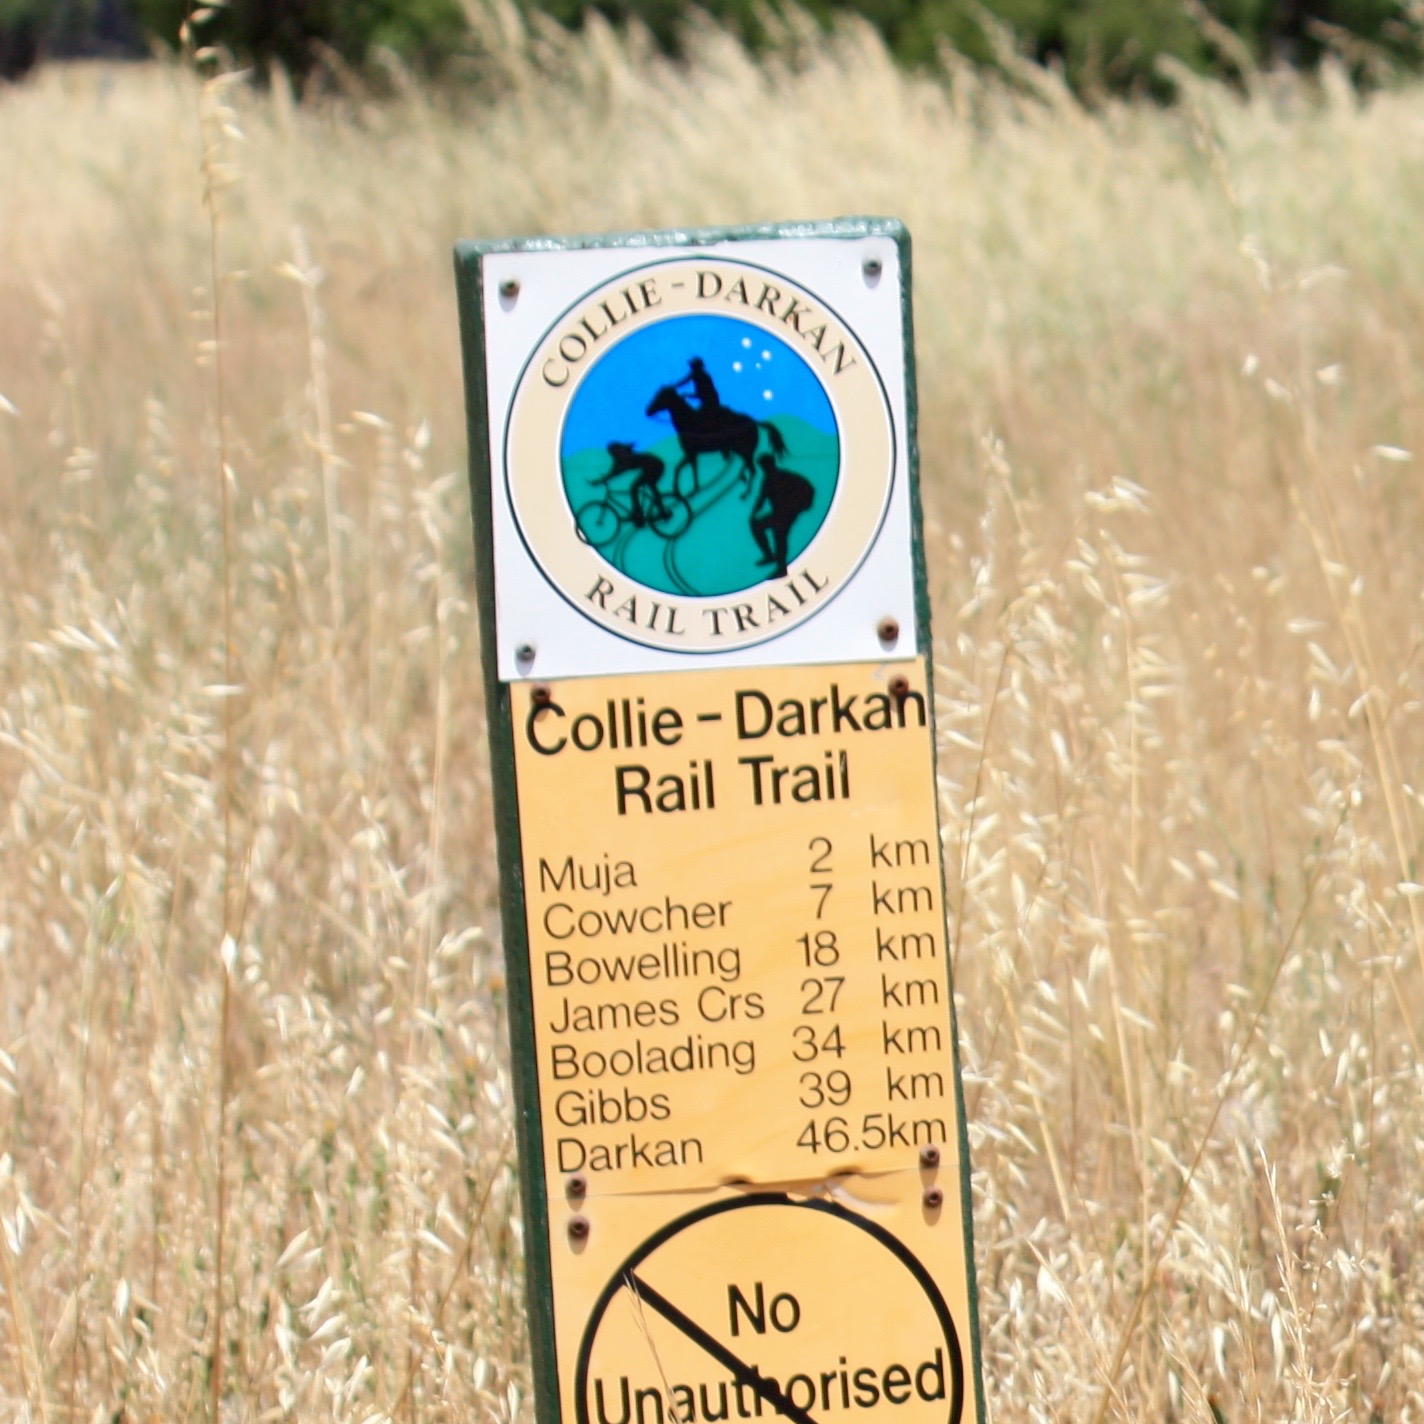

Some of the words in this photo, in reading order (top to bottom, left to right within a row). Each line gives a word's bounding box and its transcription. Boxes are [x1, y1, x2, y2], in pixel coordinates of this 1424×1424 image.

[541, 278, 663, 389] COLLIE
[695, 271, 858, 378] DARKAN
[584, 574, 686, 635] RAIL
[702, 572, 830, 636] TRAIL
[526, 697, 684, 756] Collie
[735, 684, 926, 740] Darkan
[614, 759, 716, 815] Rail
[738, 750, 849, 806] Trail
[539, 854, 638, 896] Muja
[808, 837, 833, 873] 2
[870, 834, 930, 868] km
[543, 897, 732, 940] Cowcher
[809, 884, 833, 920] 7
[872, 881, 933, 915] km
[546, 943, 741, 986] Bowelling
[796, 931, 839, 967] 18
[876, 927, 936, 961] km
[550, 998, 680, 1034] James
[697, 986, 765, 1023] Crs
[800, 977, 845, 1015] 27
[881, 975, 939, 1008] km
[552, 1036, 755, 1080] Boolading
[793, 1025, 846, 1062] 34
[882, 1021, 941, 1055] km
[555, 1088, 671, 1127] Gibbs
[798, 1071, 852, 1109] 39
[887, 1068, 945, 1101] km
[557, 1136, 704, 1174] Darkan
[797, 1114, 946, 1155] 46.5km
[726, 1282, 800, 1337] No
